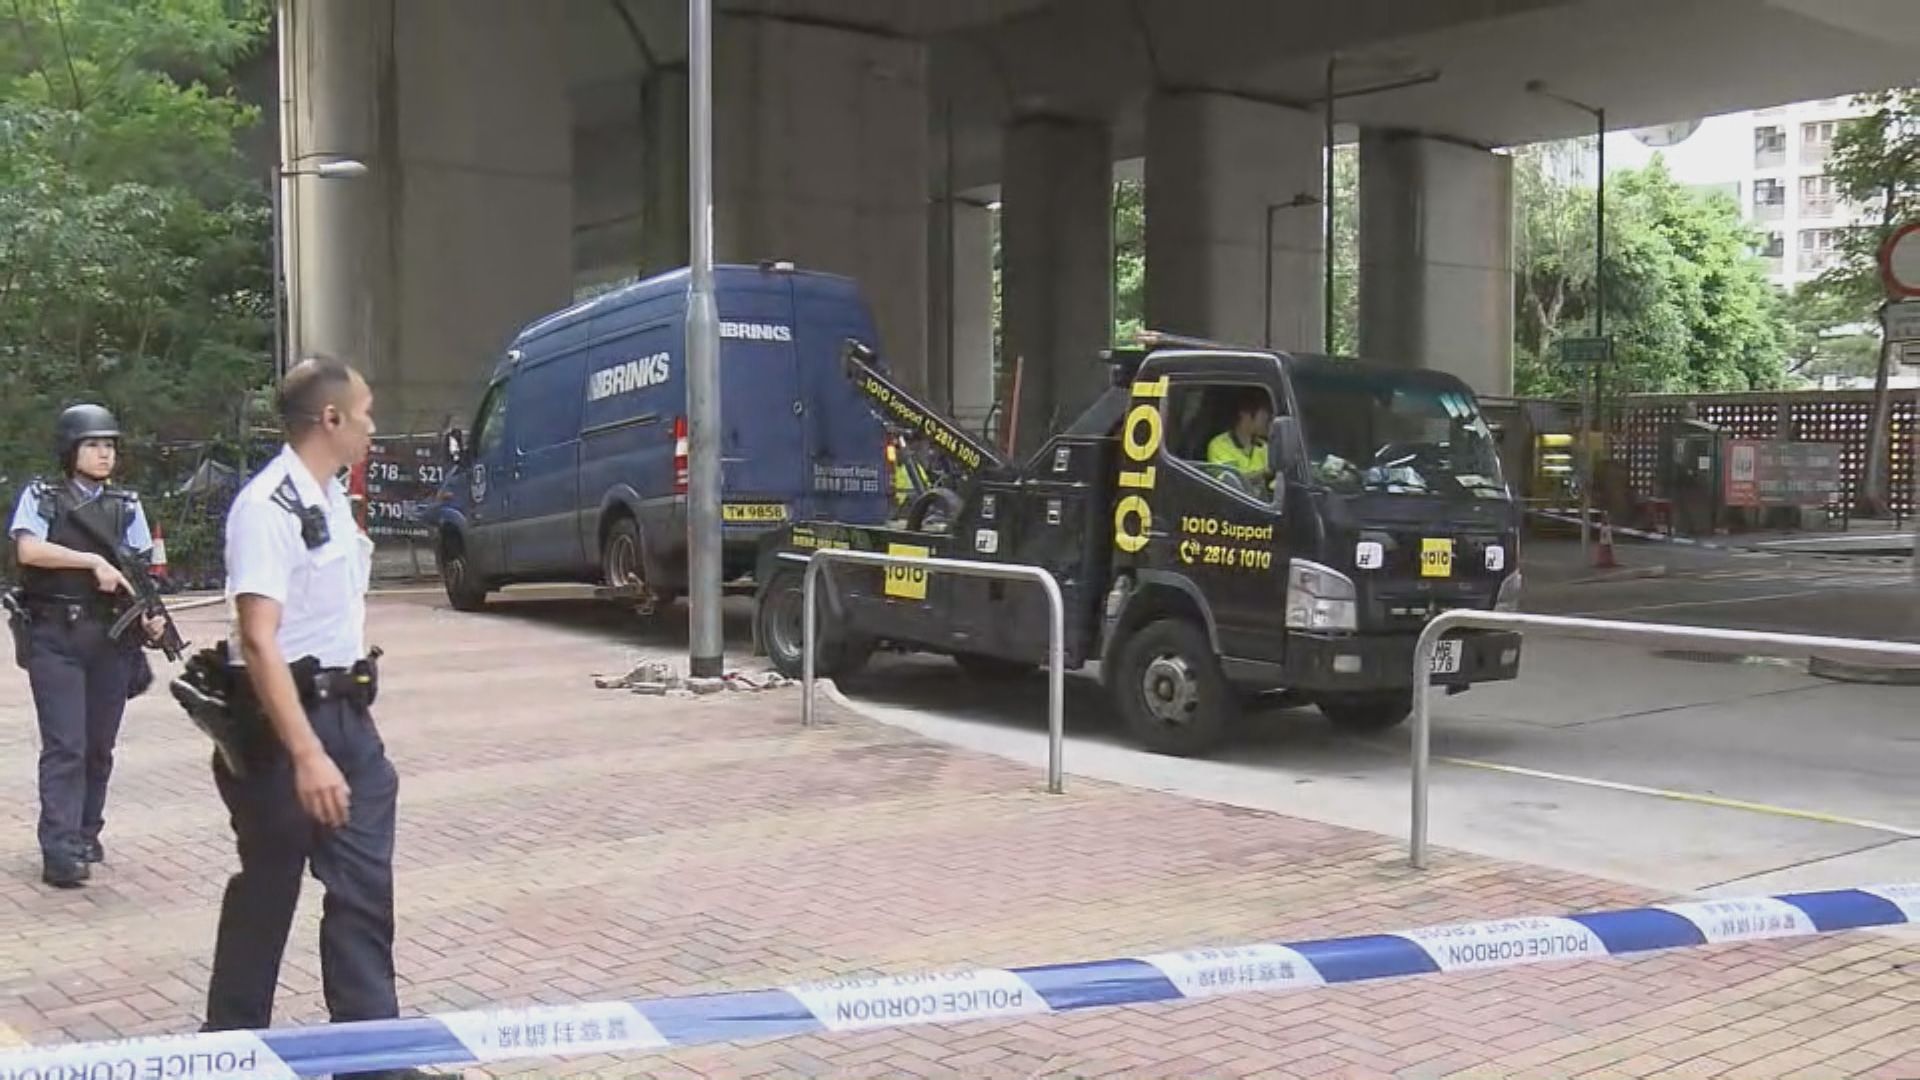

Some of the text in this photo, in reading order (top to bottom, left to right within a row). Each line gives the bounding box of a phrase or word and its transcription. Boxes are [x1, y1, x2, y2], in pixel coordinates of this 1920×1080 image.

[724, 322, 792, 341] BRINKS
[599, 352, 669, 398] BRINKS
[866, 378, 890, 402] 1010
[1114, 375, 1170, 553] 1010
[727, 505, 783, 519] TW 9858
[1181, 516, 1273, 541] 1010 Support
[1203, 545, 1272, 568] 2816 1010
[1422, 550, 1450, 566] 1010
[887, 566, 924, 583] 1010
[1451, 933, 1589, 964] POLICE CORDON
[836, 989, 1023, 1022] POLICE CORDON
[145, 1049, 257, 1078] POLICE
